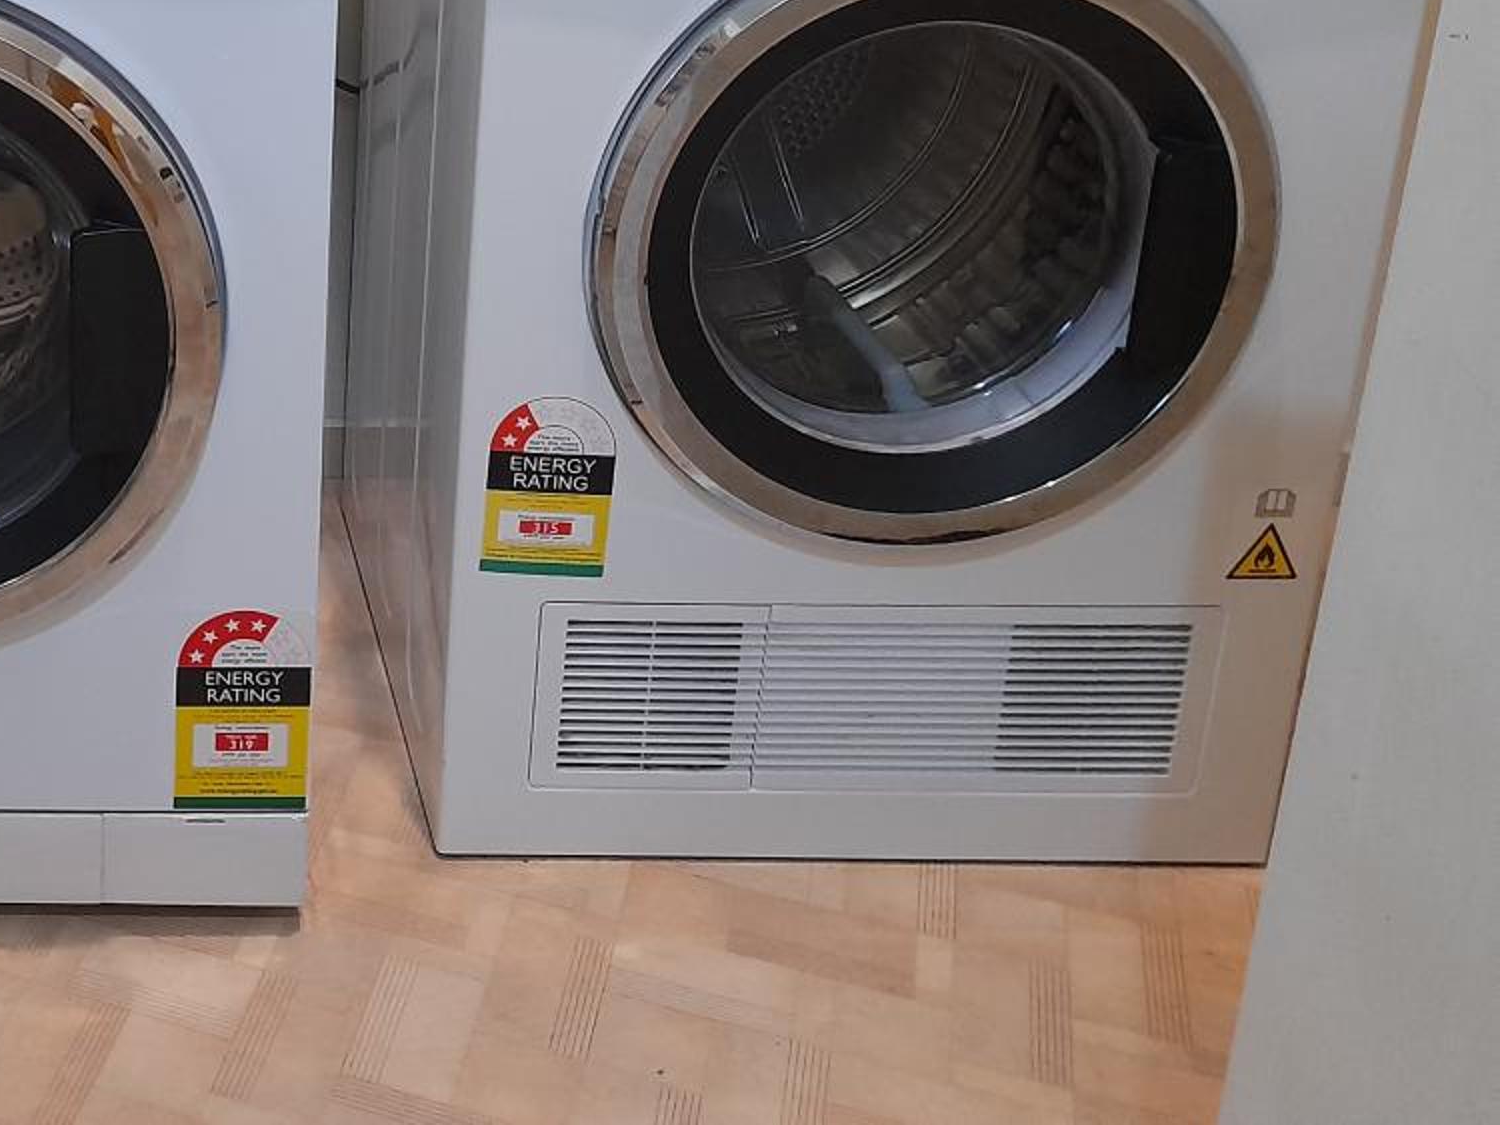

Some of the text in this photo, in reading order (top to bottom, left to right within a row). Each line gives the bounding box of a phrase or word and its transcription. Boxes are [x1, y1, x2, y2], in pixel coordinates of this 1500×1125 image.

[509, 455, 597, 474] ENERGY
[513, 473, 589, 491] RATING
[205, 671, 284, 687] ENERGY
[207, 688, 281, 704] RATING
